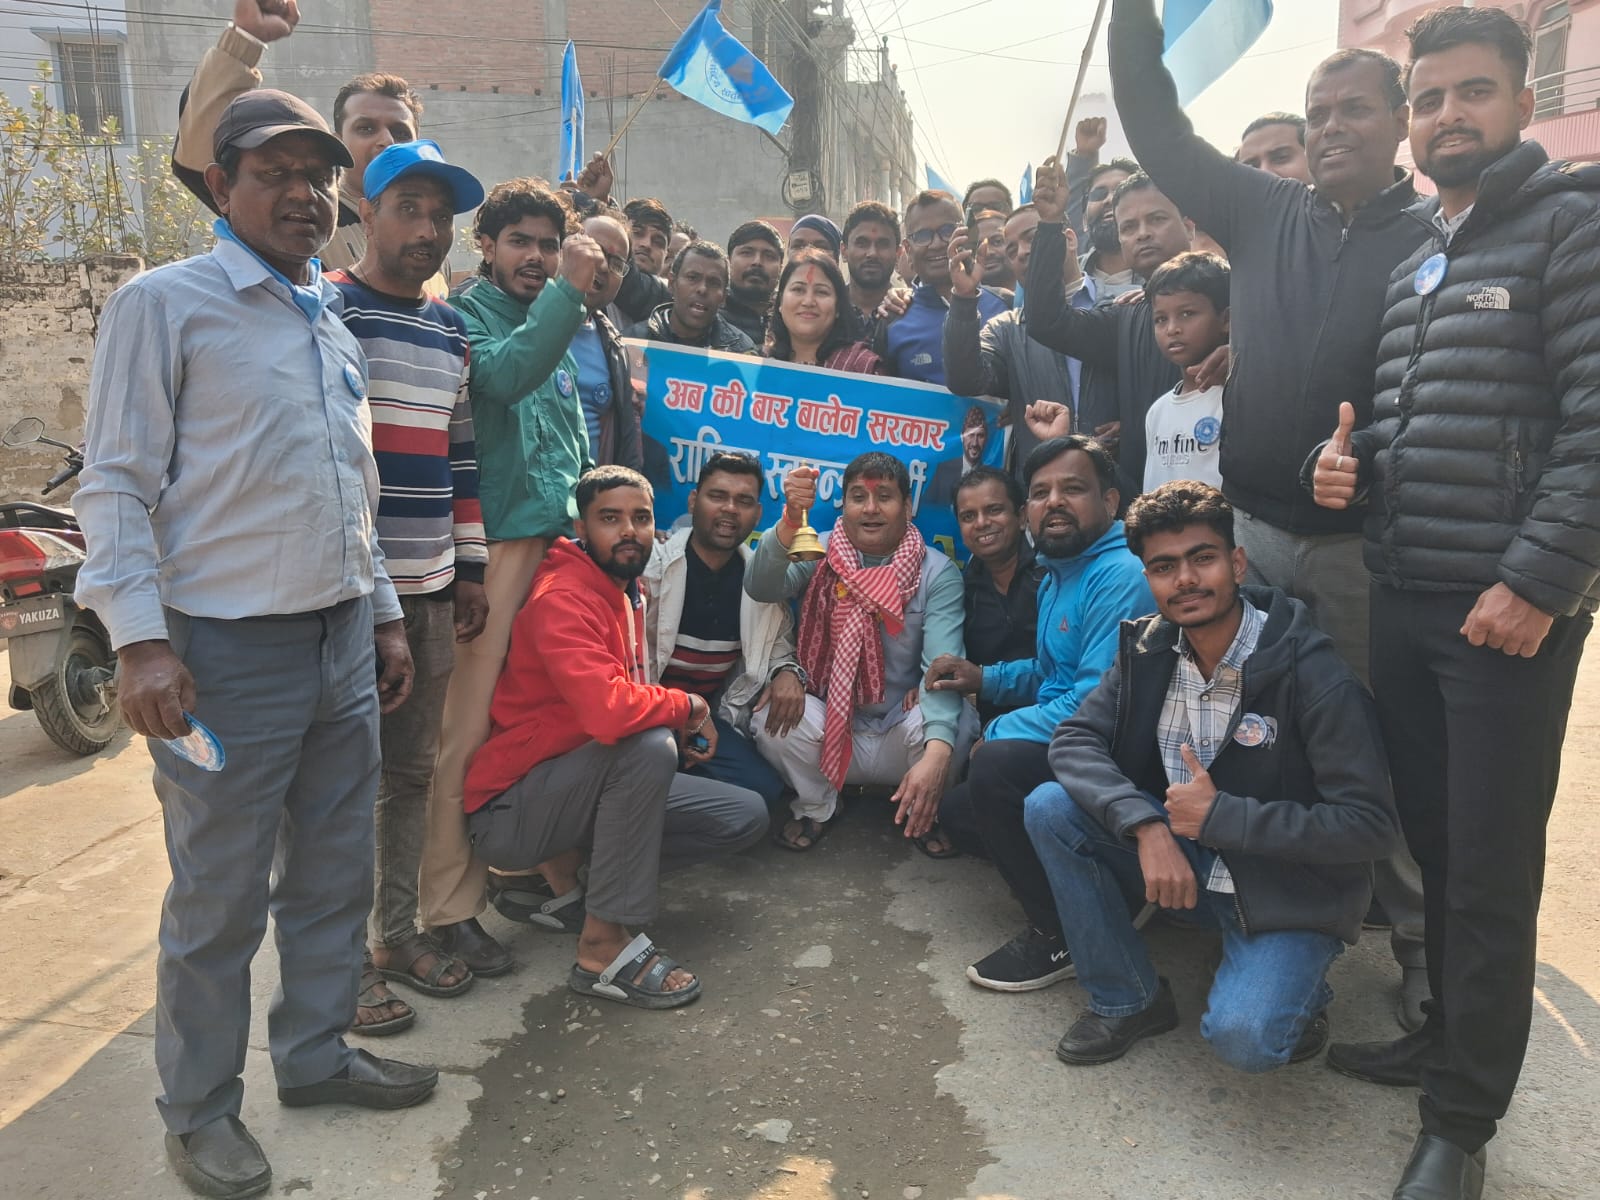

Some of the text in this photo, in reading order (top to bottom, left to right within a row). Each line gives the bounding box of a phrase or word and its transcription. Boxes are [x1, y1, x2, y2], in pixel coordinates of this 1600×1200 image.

[1481, 286, 1497, 294] THE
[1466, 294, 1495, 302] NORTH
[1474, 302, 1495, 310] FACE
[665, 379, 949, 450] अब की बार बालेन सरकार
[19, 608, 60, 624] YAKUZA
